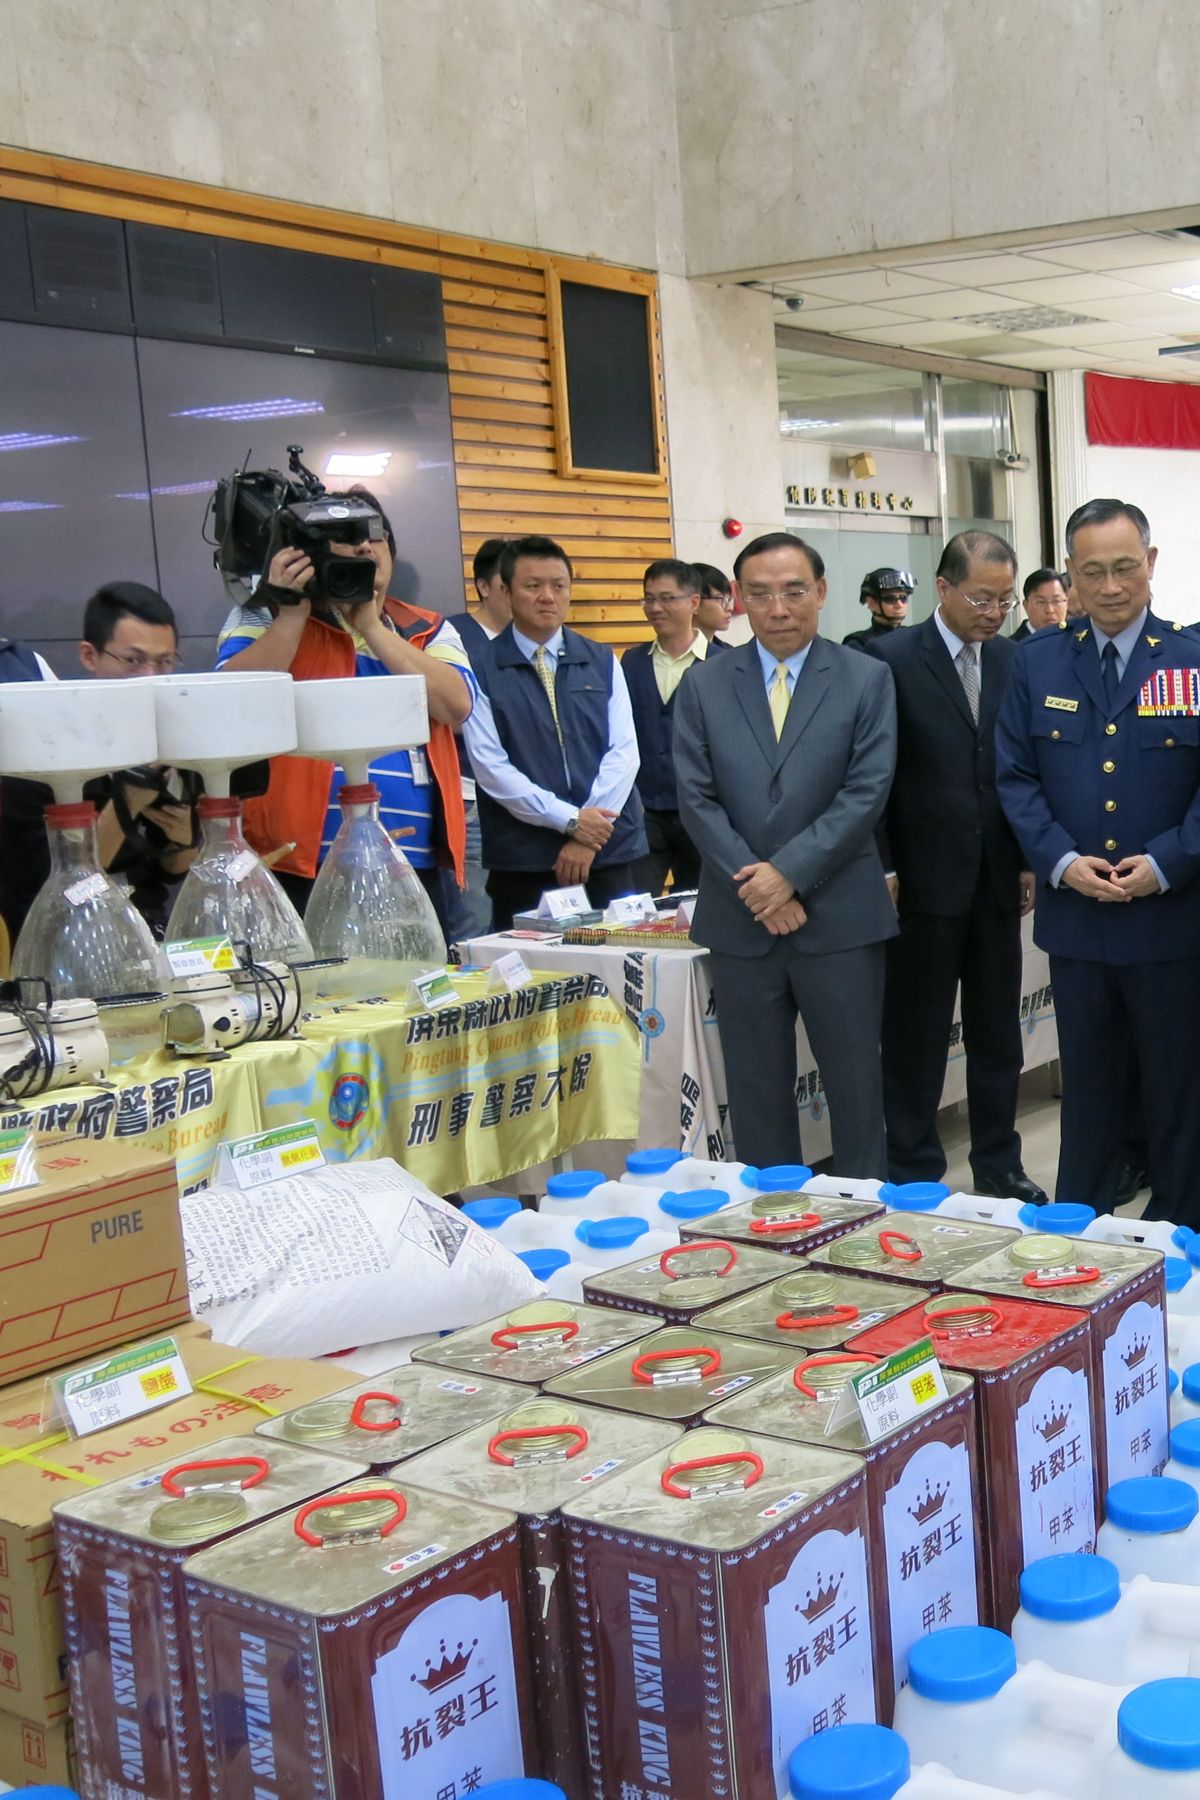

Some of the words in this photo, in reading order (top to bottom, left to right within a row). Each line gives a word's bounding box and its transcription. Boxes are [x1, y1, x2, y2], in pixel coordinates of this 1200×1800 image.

[402, 1041, 470, 1075] Pingtung
[406, 1051, 593, 1147] 刑事警察大隊
[90, 1208, 144, 1244] PURE
[912, 1372, 937, 1400] 甲苯
[1115, 1363, 1159, 1416] 抗裂王
[1030, 1434, 1083, 1493] 抗裂王
[1130, 1428, 1152, 1463] 甲苯
[900, 1513, 963, 1581] 抗裂王
[1049, 1506, 1075, 1545] 甲苯
[105, 1568, 138, 1709] FLAWLESS
[627, 1572, 665, 1713] FLAWLESS
[785, 1605, 858, 1687] 抗裂王
[922, 1591, 953, 1634] 甲苯
[240, 1631, 276, 1780] FLAWLESS
[400, 1674, 499, 1762] 抗裂王
[116, 1716, 145, 1785] KING
[638, 1719, 672, 1787] KING
